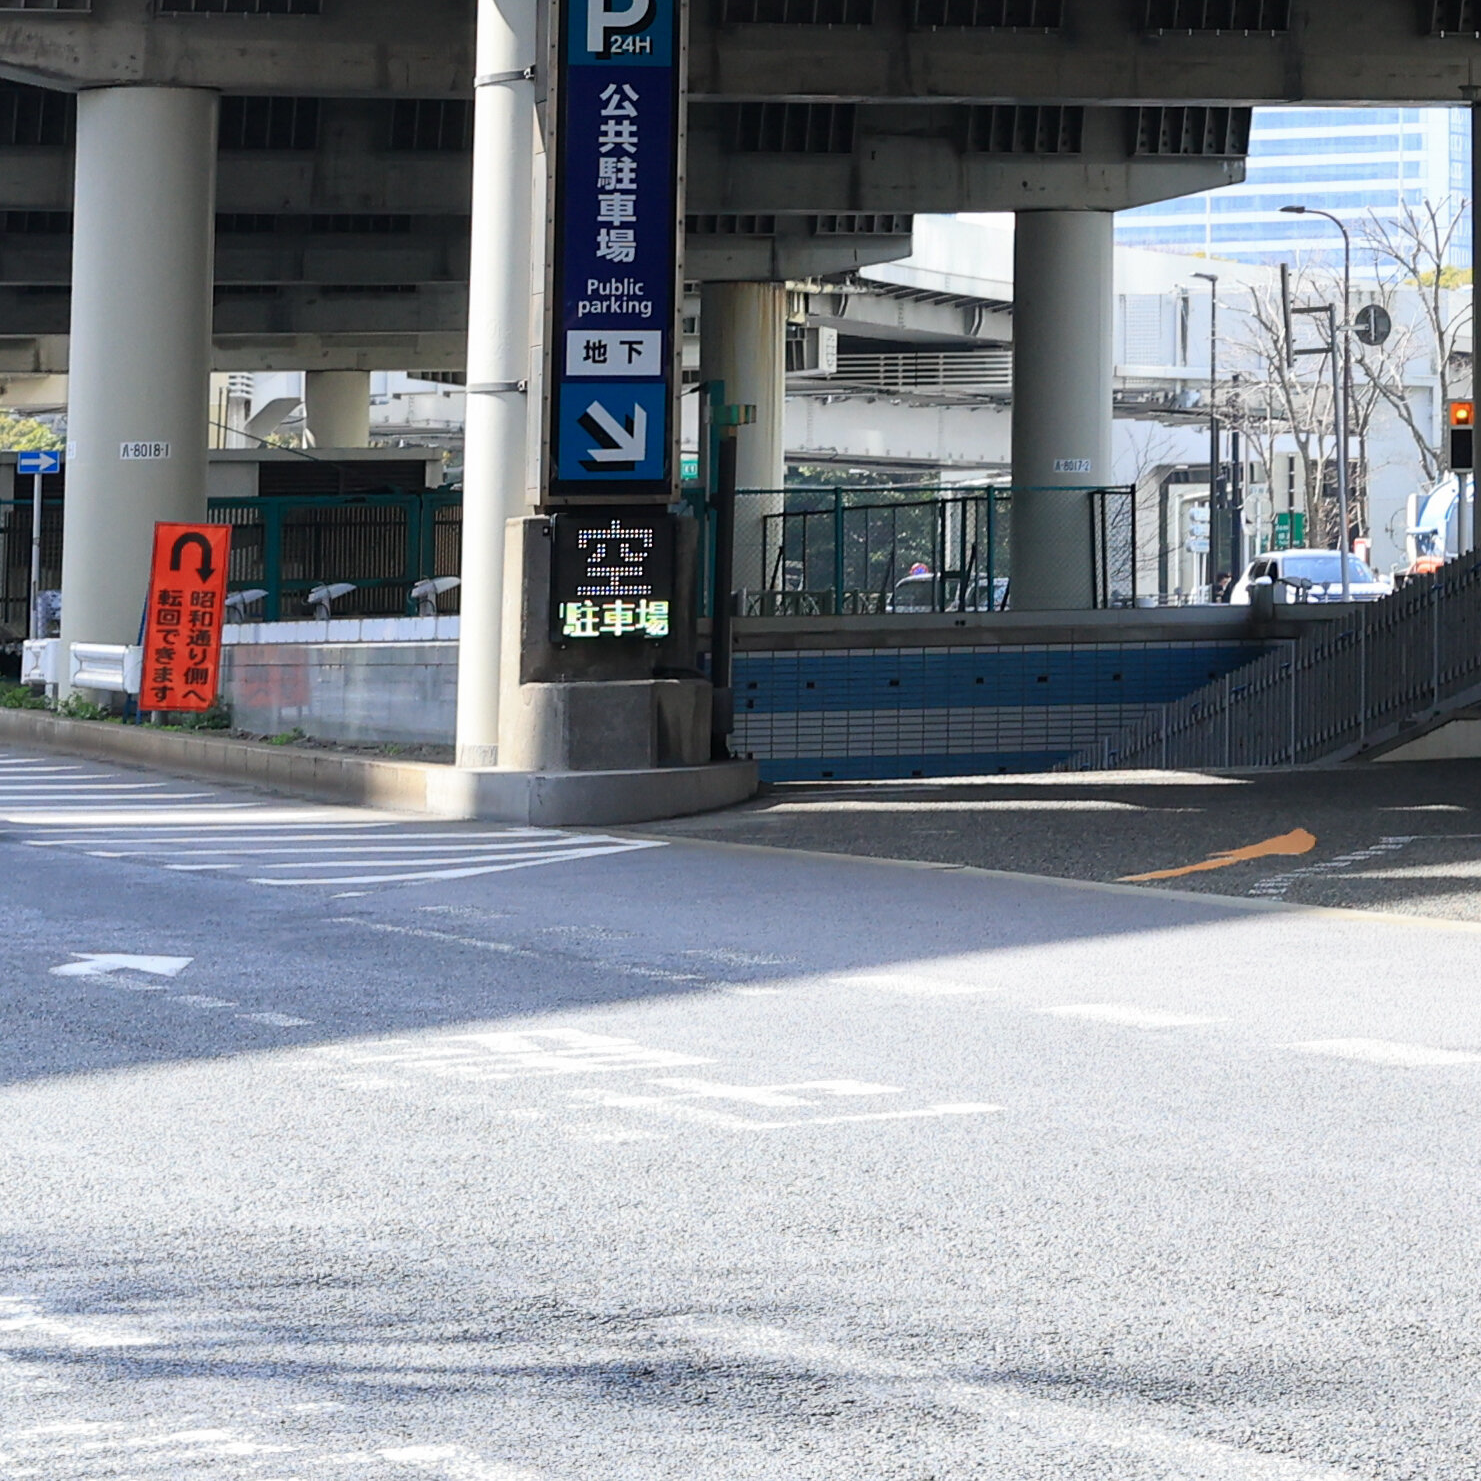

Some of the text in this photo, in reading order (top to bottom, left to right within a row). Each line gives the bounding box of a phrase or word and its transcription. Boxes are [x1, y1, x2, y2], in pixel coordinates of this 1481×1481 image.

[611, 35, 651, 53] 24H
[596, 83, 639, 263] 公共駐車場
[578, 296, 653, 318] parking
[587, 278, 644, 296] Public
[583, 340, 644, 365] 地下
[577, 519, 653, 596] 空
[559, 598, 669, 638] 駐車場
[150, 588, 184, 703] 転回できます
[182, 590, 217, 702] 昭和通り側へ
